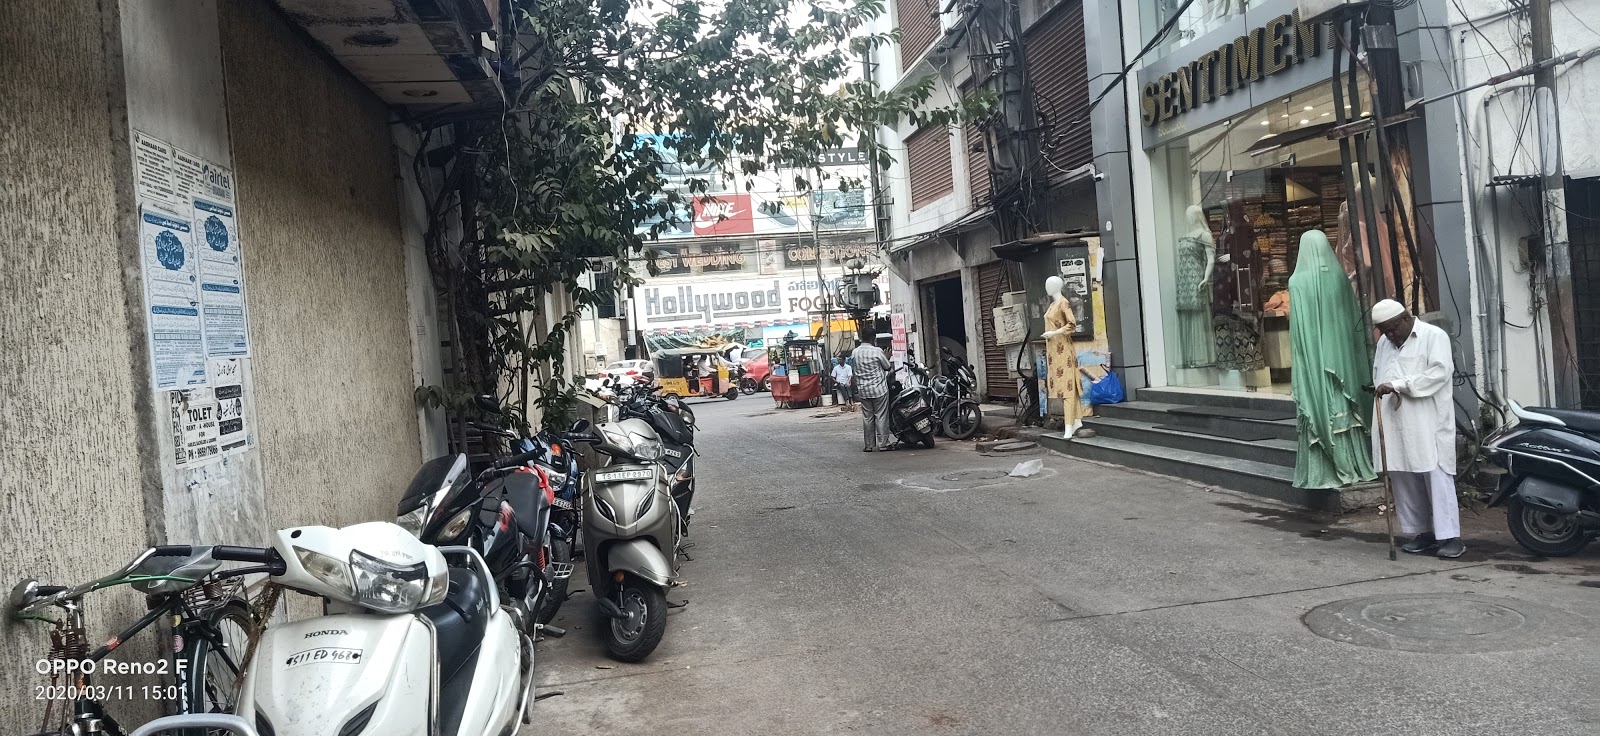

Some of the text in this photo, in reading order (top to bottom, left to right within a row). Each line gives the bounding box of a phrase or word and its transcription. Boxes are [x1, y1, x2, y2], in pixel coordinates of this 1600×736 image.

[209, 168, 231, 190] airtel
[682, 252, 745, 267] WEDDING
[644, 280, 782, 323] Hollywood
[187, 407, 212, 422] TOLET
[304, 629, 349, 639] HONDA
